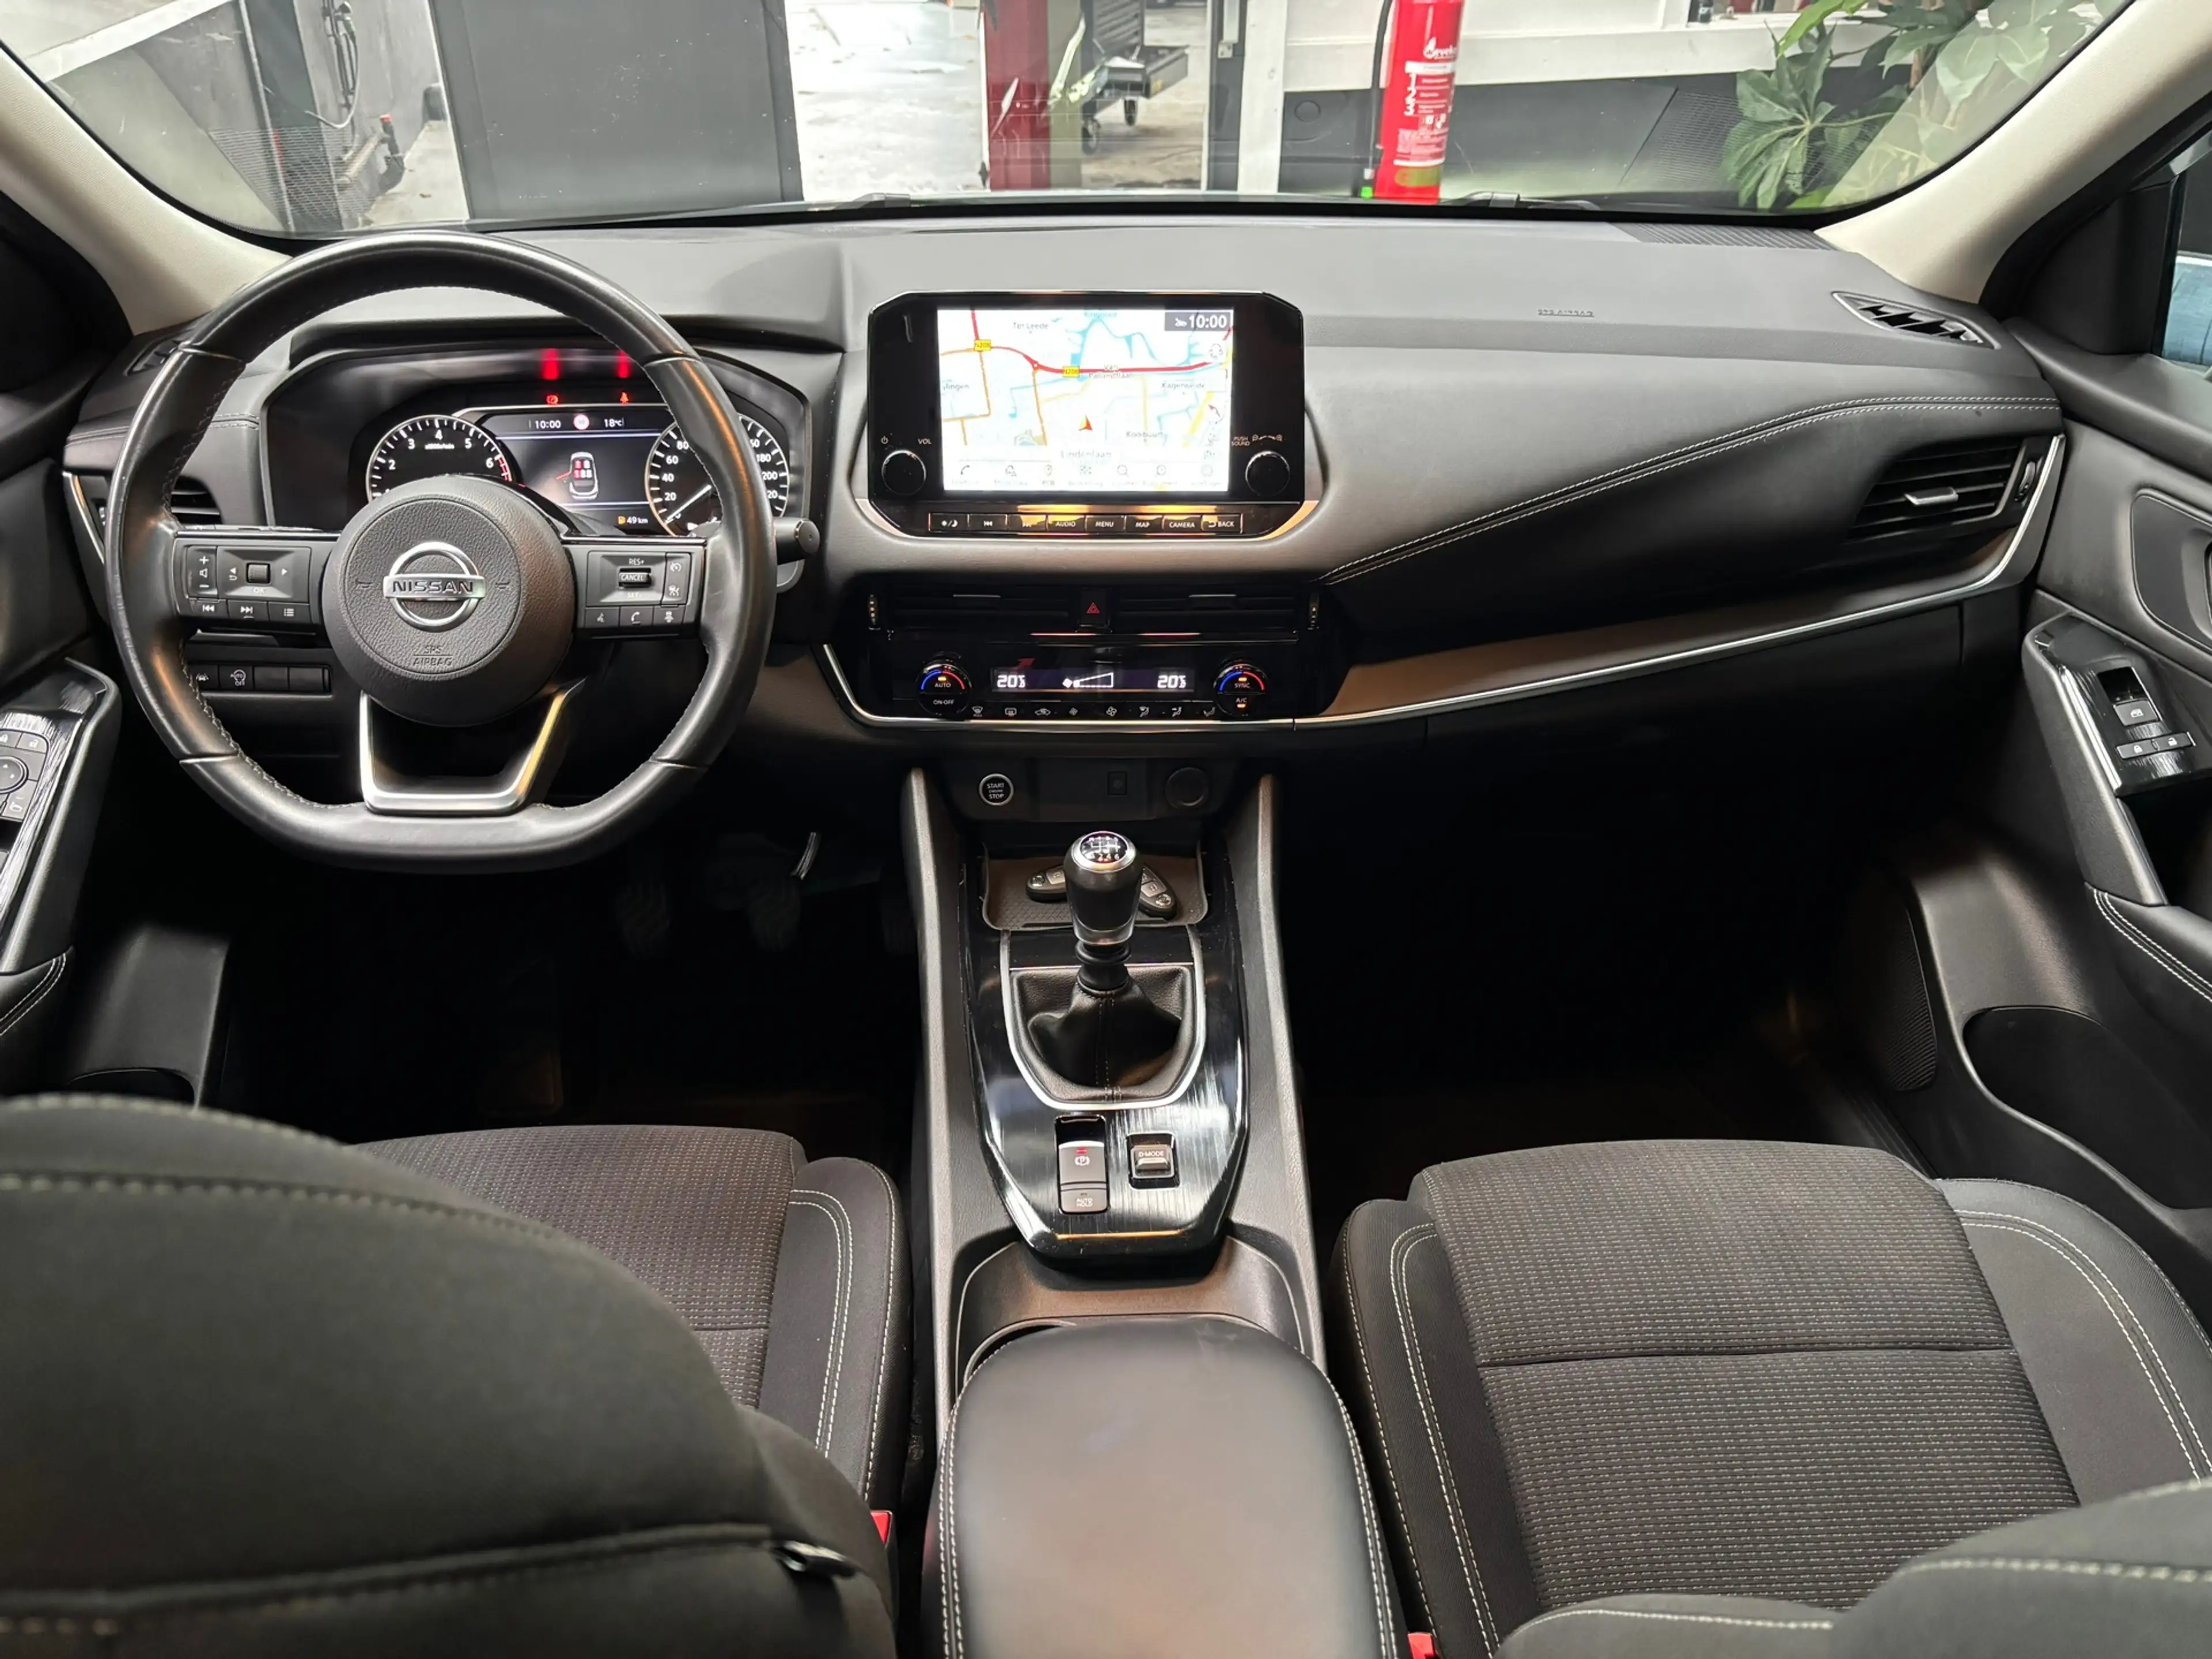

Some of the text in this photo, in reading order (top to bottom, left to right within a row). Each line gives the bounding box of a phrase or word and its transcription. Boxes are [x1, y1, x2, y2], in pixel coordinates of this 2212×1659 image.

[1189, 315, 1227, 328] 10:00
[535, 420, 561, 429] 10:00
[435, 429, 442, 440] 4
[408, 439, 415, 449] 3
[465, 438, 472, 449] 5
[677, 441, 688, 450] 80
[388, 459, 396, 469] 2
[486, 457, 493, 468] 6
[666, 455, 679, 464] 60
[662, 473, 674, 482] 40
[762, 471, 778, 480] 200
[665, 492, 676, 501] 20
[767, 490, 778, 499] 20
[627, 516, 637, 524] 49
[392, 580, 474, 594] NISSAN
